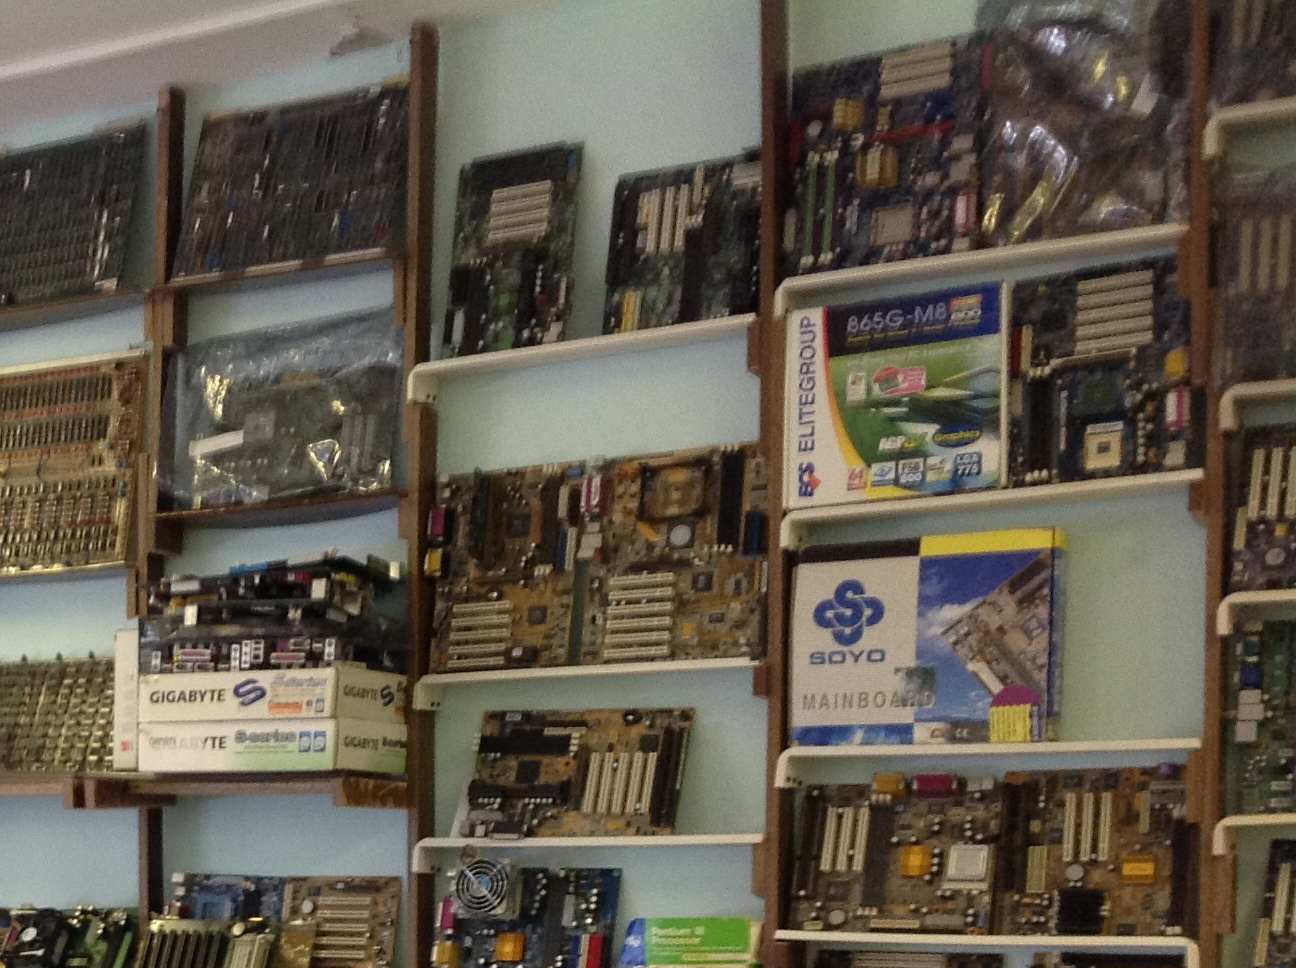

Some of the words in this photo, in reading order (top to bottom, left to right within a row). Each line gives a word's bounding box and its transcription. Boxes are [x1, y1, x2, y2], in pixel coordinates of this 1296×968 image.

[798, 316, 818, 452] ELITEGROUP
[809, 648, 886, 665] SOYO
[149, 688, 227, 704] GIGABYTE
